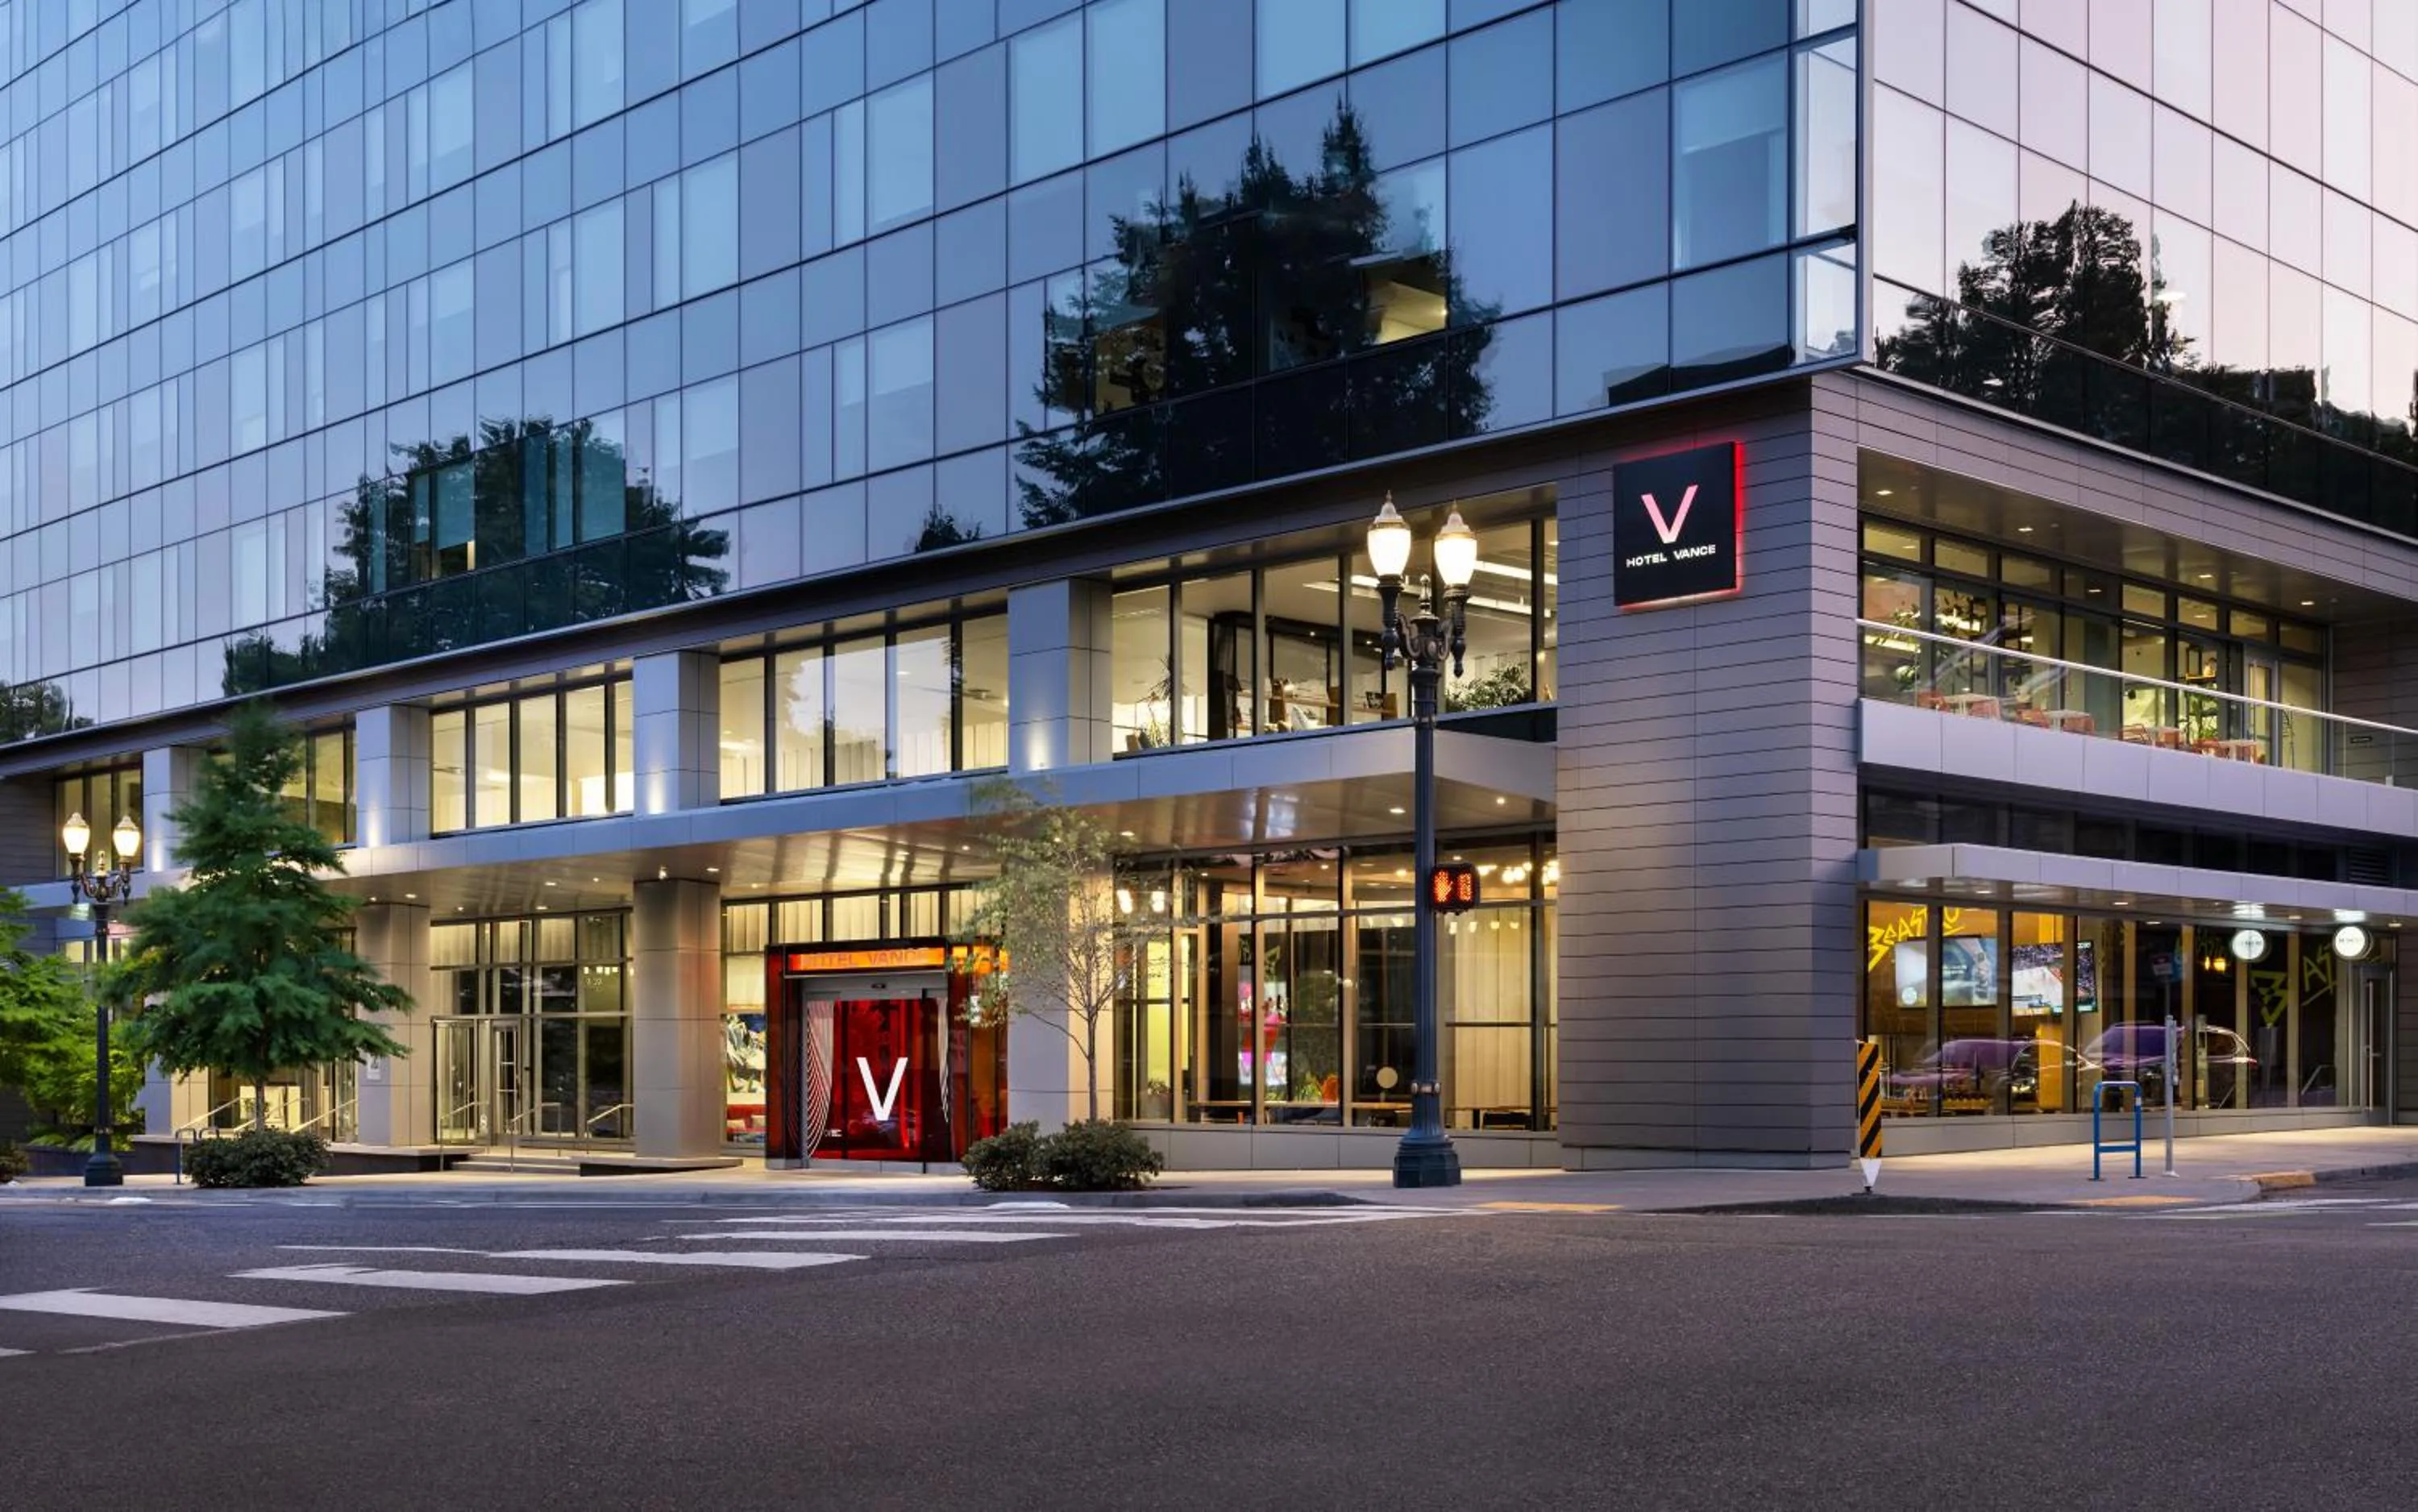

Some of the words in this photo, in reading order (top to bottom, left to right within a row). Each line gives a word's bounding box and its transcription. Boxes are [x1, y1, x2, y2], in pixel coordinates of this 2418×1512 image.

[1641, 484, 1699, 544] V
[1626, 552, 1668, 567] HOTEL
[1673, 544, 1716, 560] VANCE
[800, 953, 858, 969] OTEL
[867, 948, 929, 966] VANC
[856, 1057, 908, 1121] V
